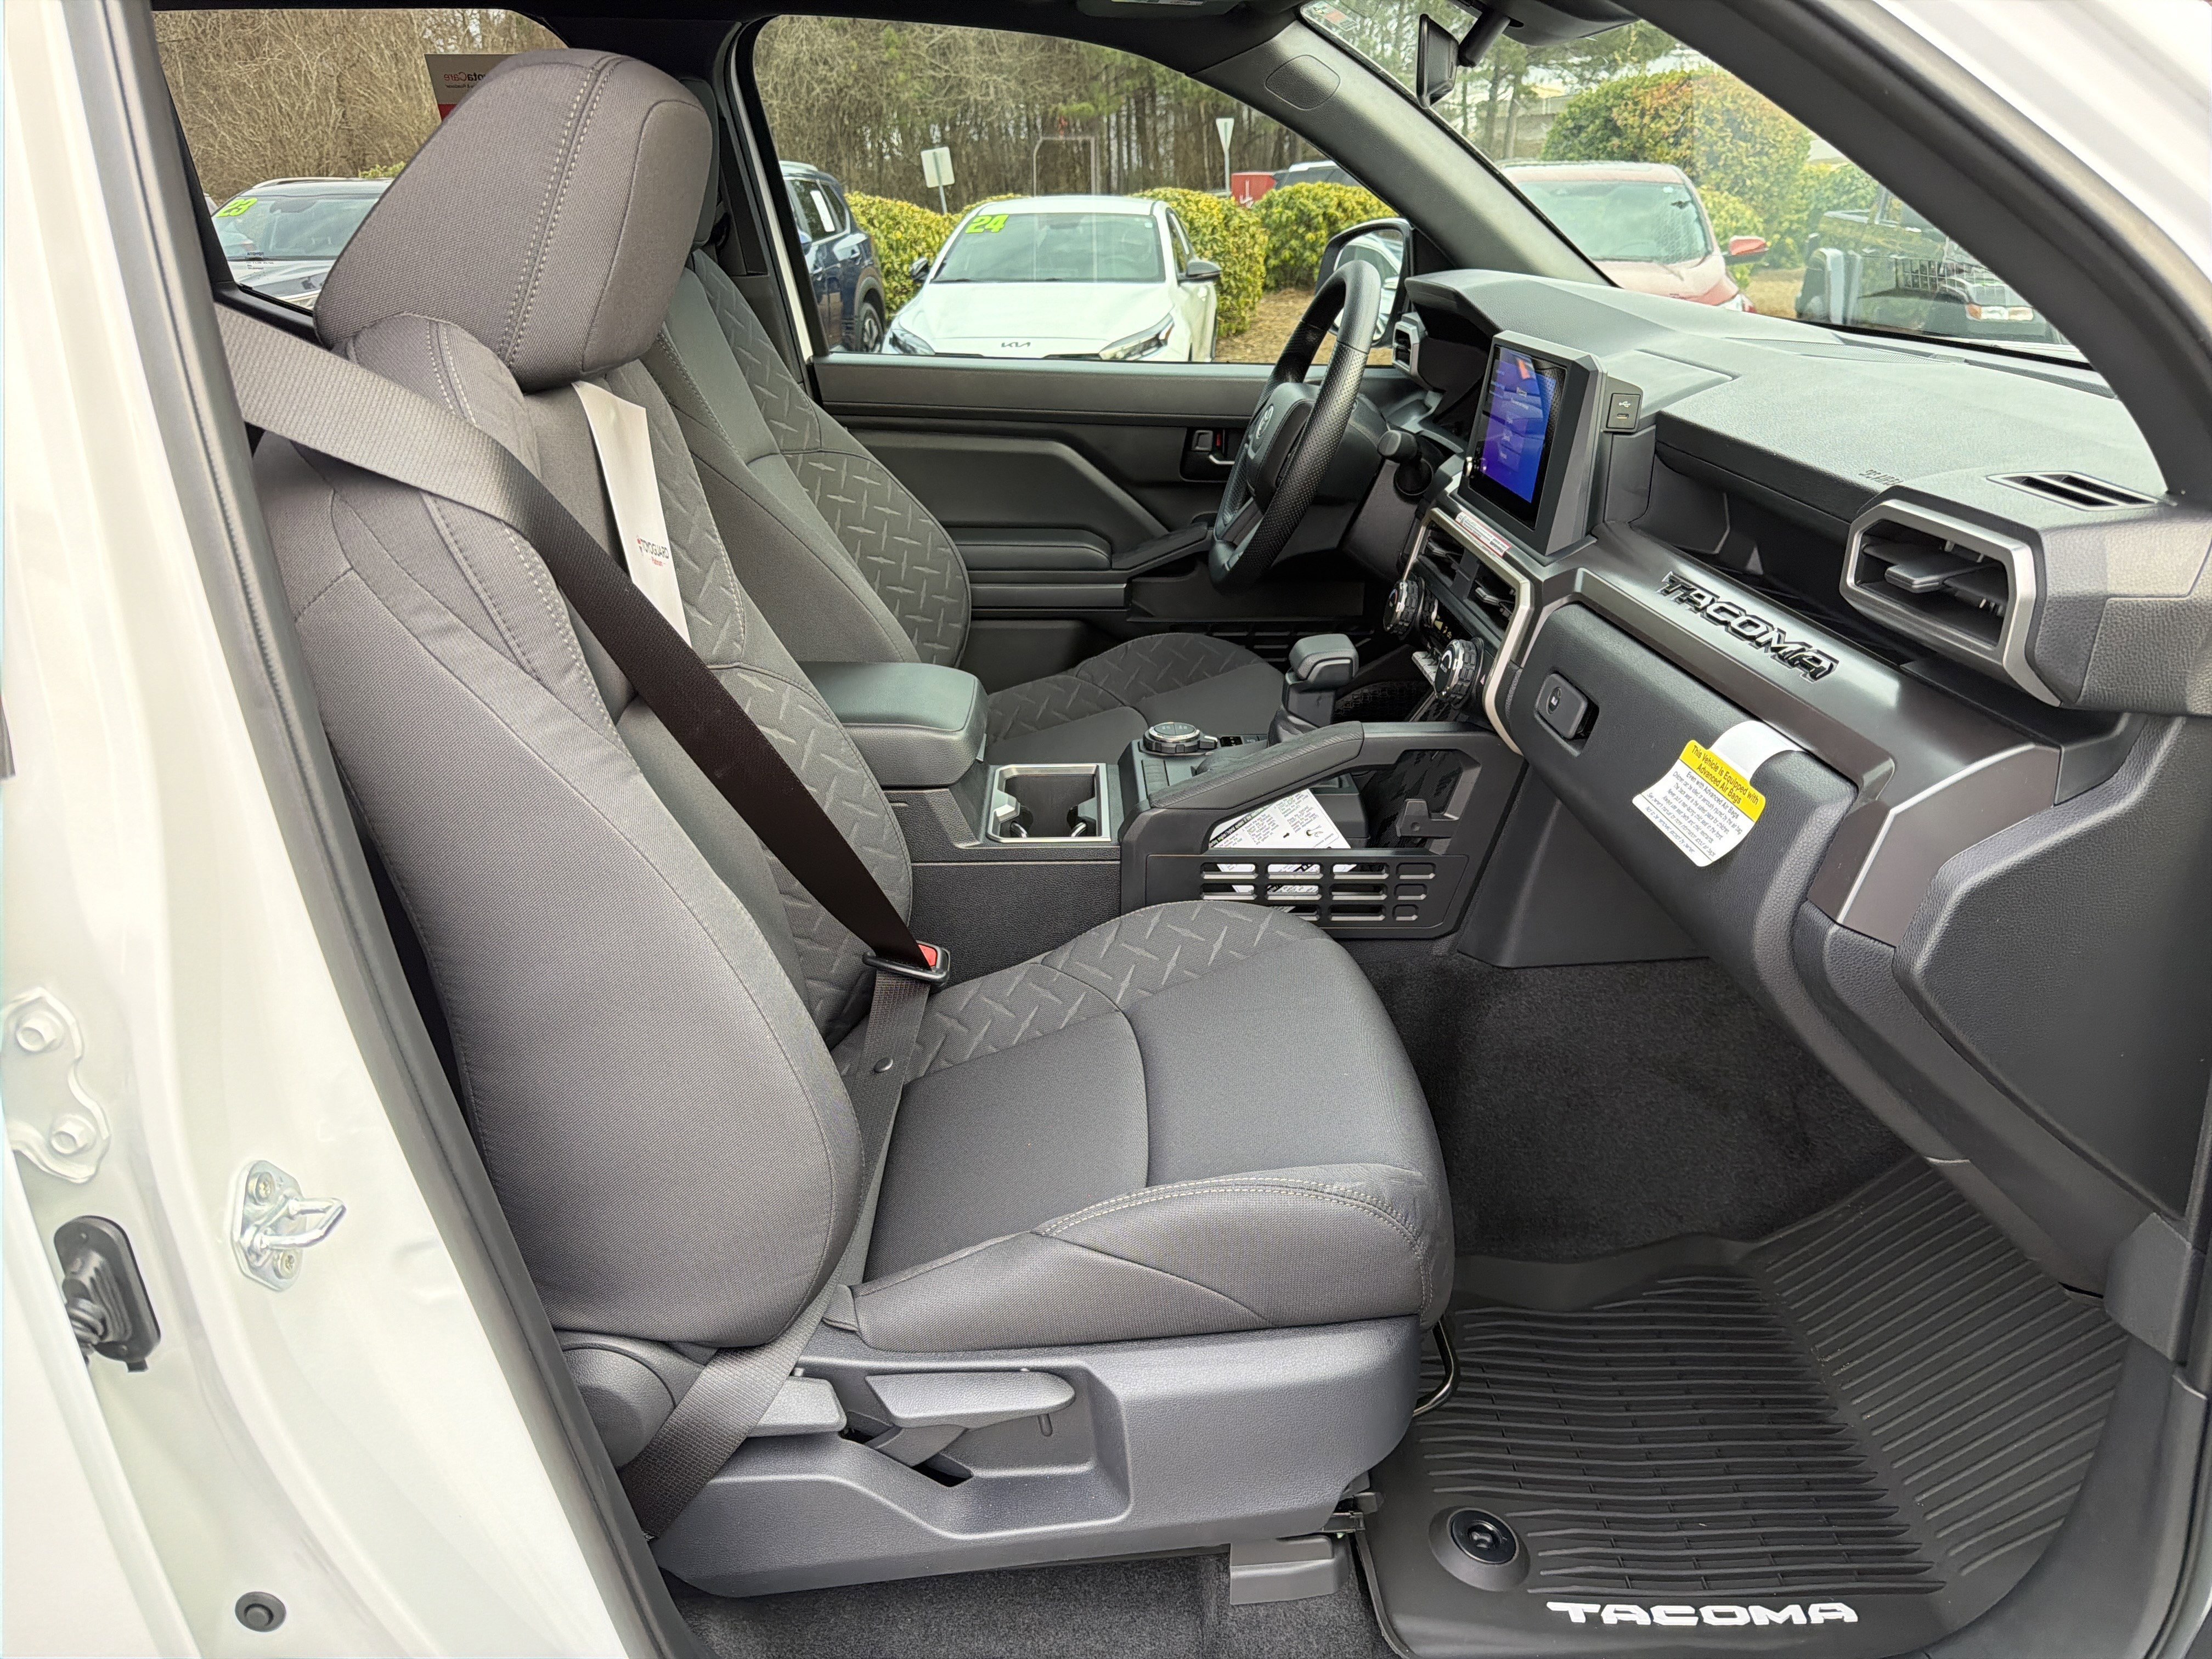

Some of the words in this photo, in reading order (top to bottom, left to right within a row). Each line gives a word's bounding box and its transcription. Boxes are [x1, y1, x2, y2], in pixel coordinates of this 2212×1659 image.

[216, 198, 258, 217] 23
[966, 213, 1009, 233] 24
[1656, 571, 1839, 684] TACOMA
[1685, 771, 1698, 782] Even
[1694, 780, 1706, 789] with
[1702, 786, 1724, 804] Advanced
[1720, 802, 1730, 810] Air
[1725, 806, 1741, 820] Bags
[1690, 744, 1703, 759] This
[1700, 753, 1720, 772] Vehicle
[1718, 766, 1725, 776] is
[1722, 771, 1748, 798] Equipped
[1746, 790, 1759, 805] with
[1696, 762, 1722, 787] Advanced
[1719, 781, 1730, 794] Air
[1726, 788, 1742, 806] Bags
[1547, 1601, 1858, 1626] TACOMA
